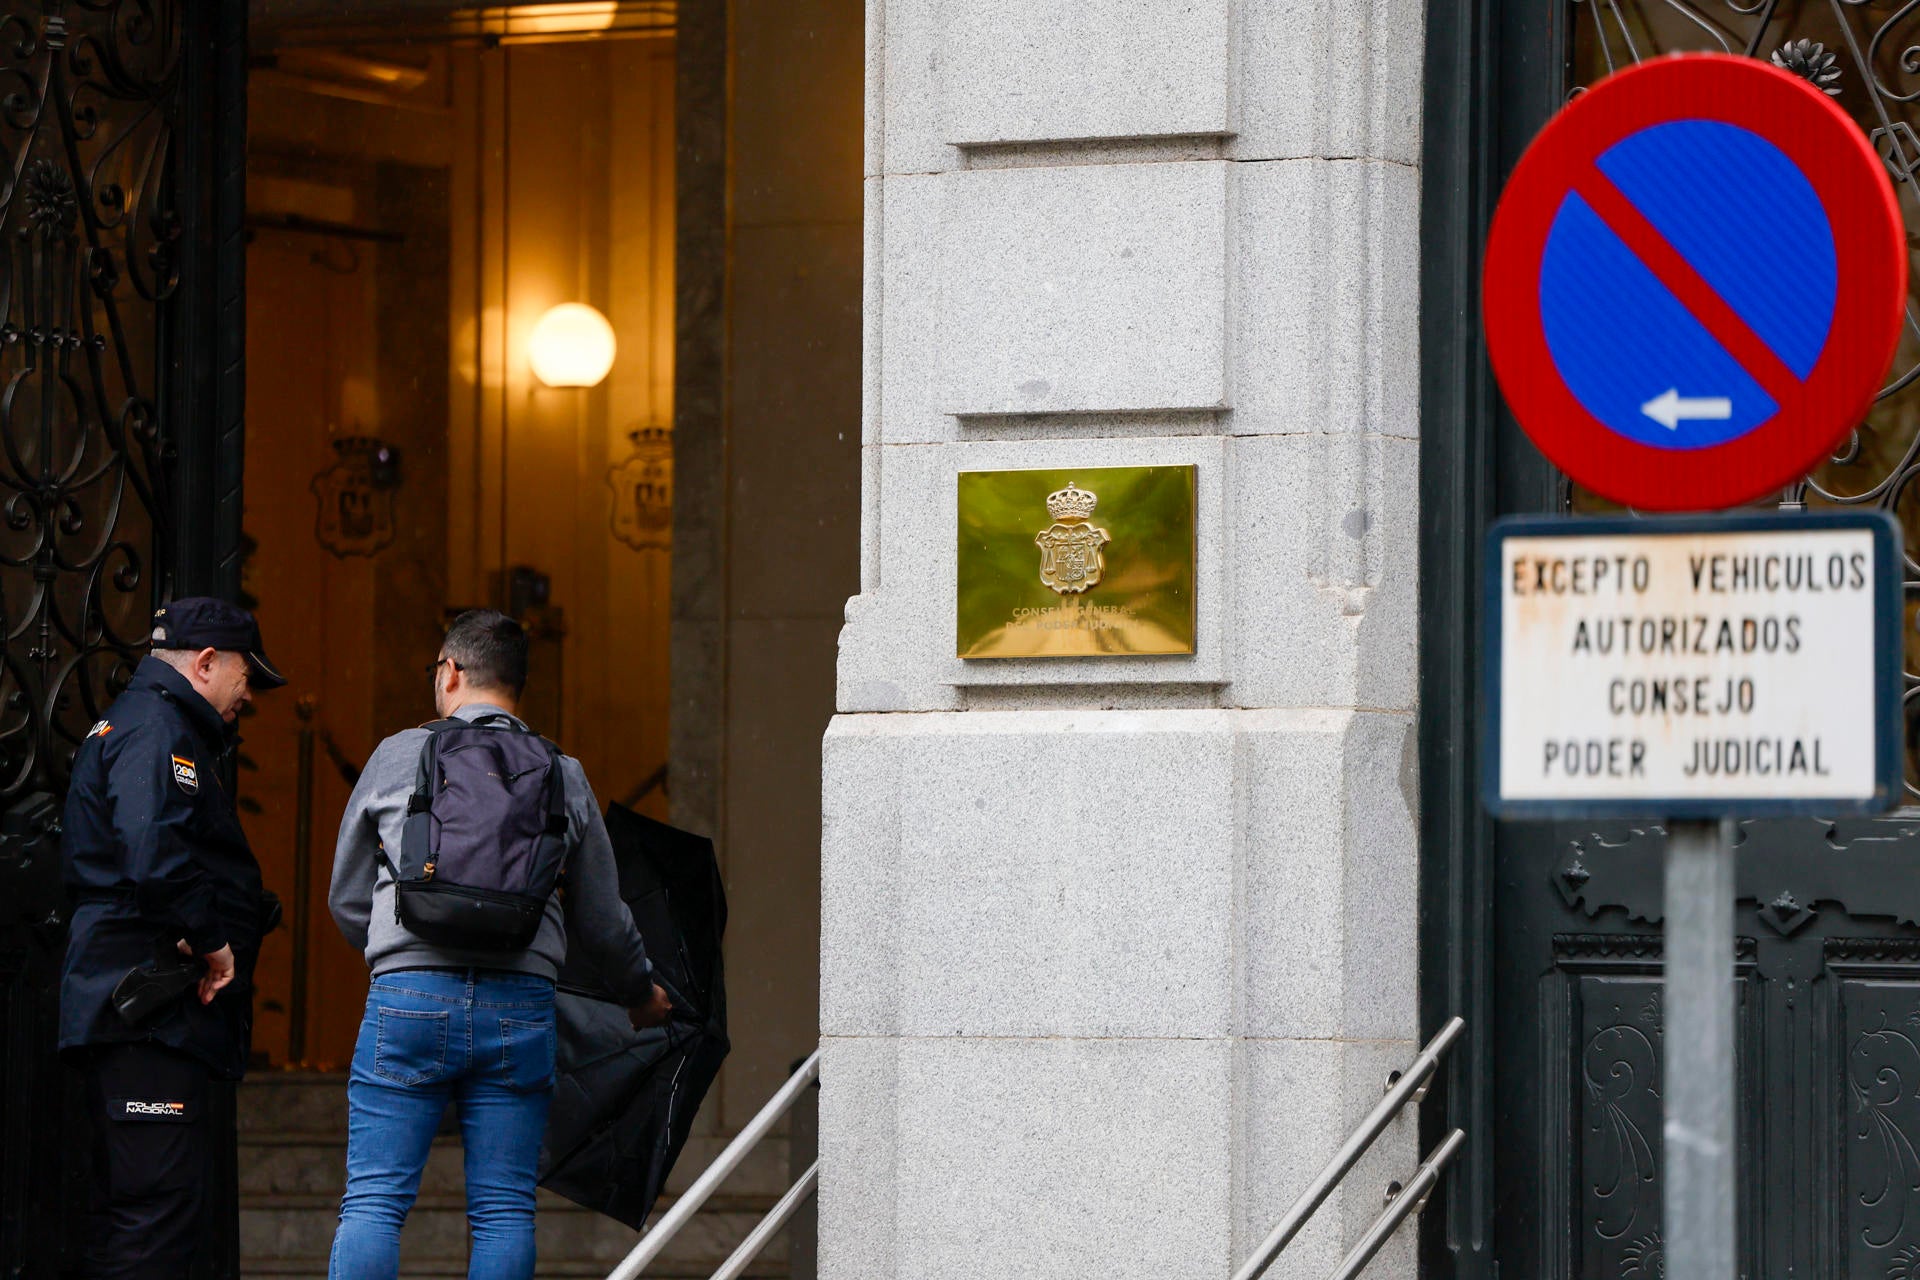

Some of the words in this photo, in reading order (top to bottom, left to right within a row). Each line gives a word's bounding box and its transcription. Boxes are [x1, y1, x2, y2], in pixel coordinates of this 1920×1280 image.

[1512, 555, 1650, 594] EXCEPTO
[1690, 552, 1866, 592] VEHICULOS
[1012, 607, 1070, 618] CONSE
[1572, 616, 1801, 655] AUTORIZADOS
[1608, 678, 1756, 716] CONSEJO
[1543, 737, 1647, 777] PODER
[1683, 737, 1830, 777] JUDICIAL
